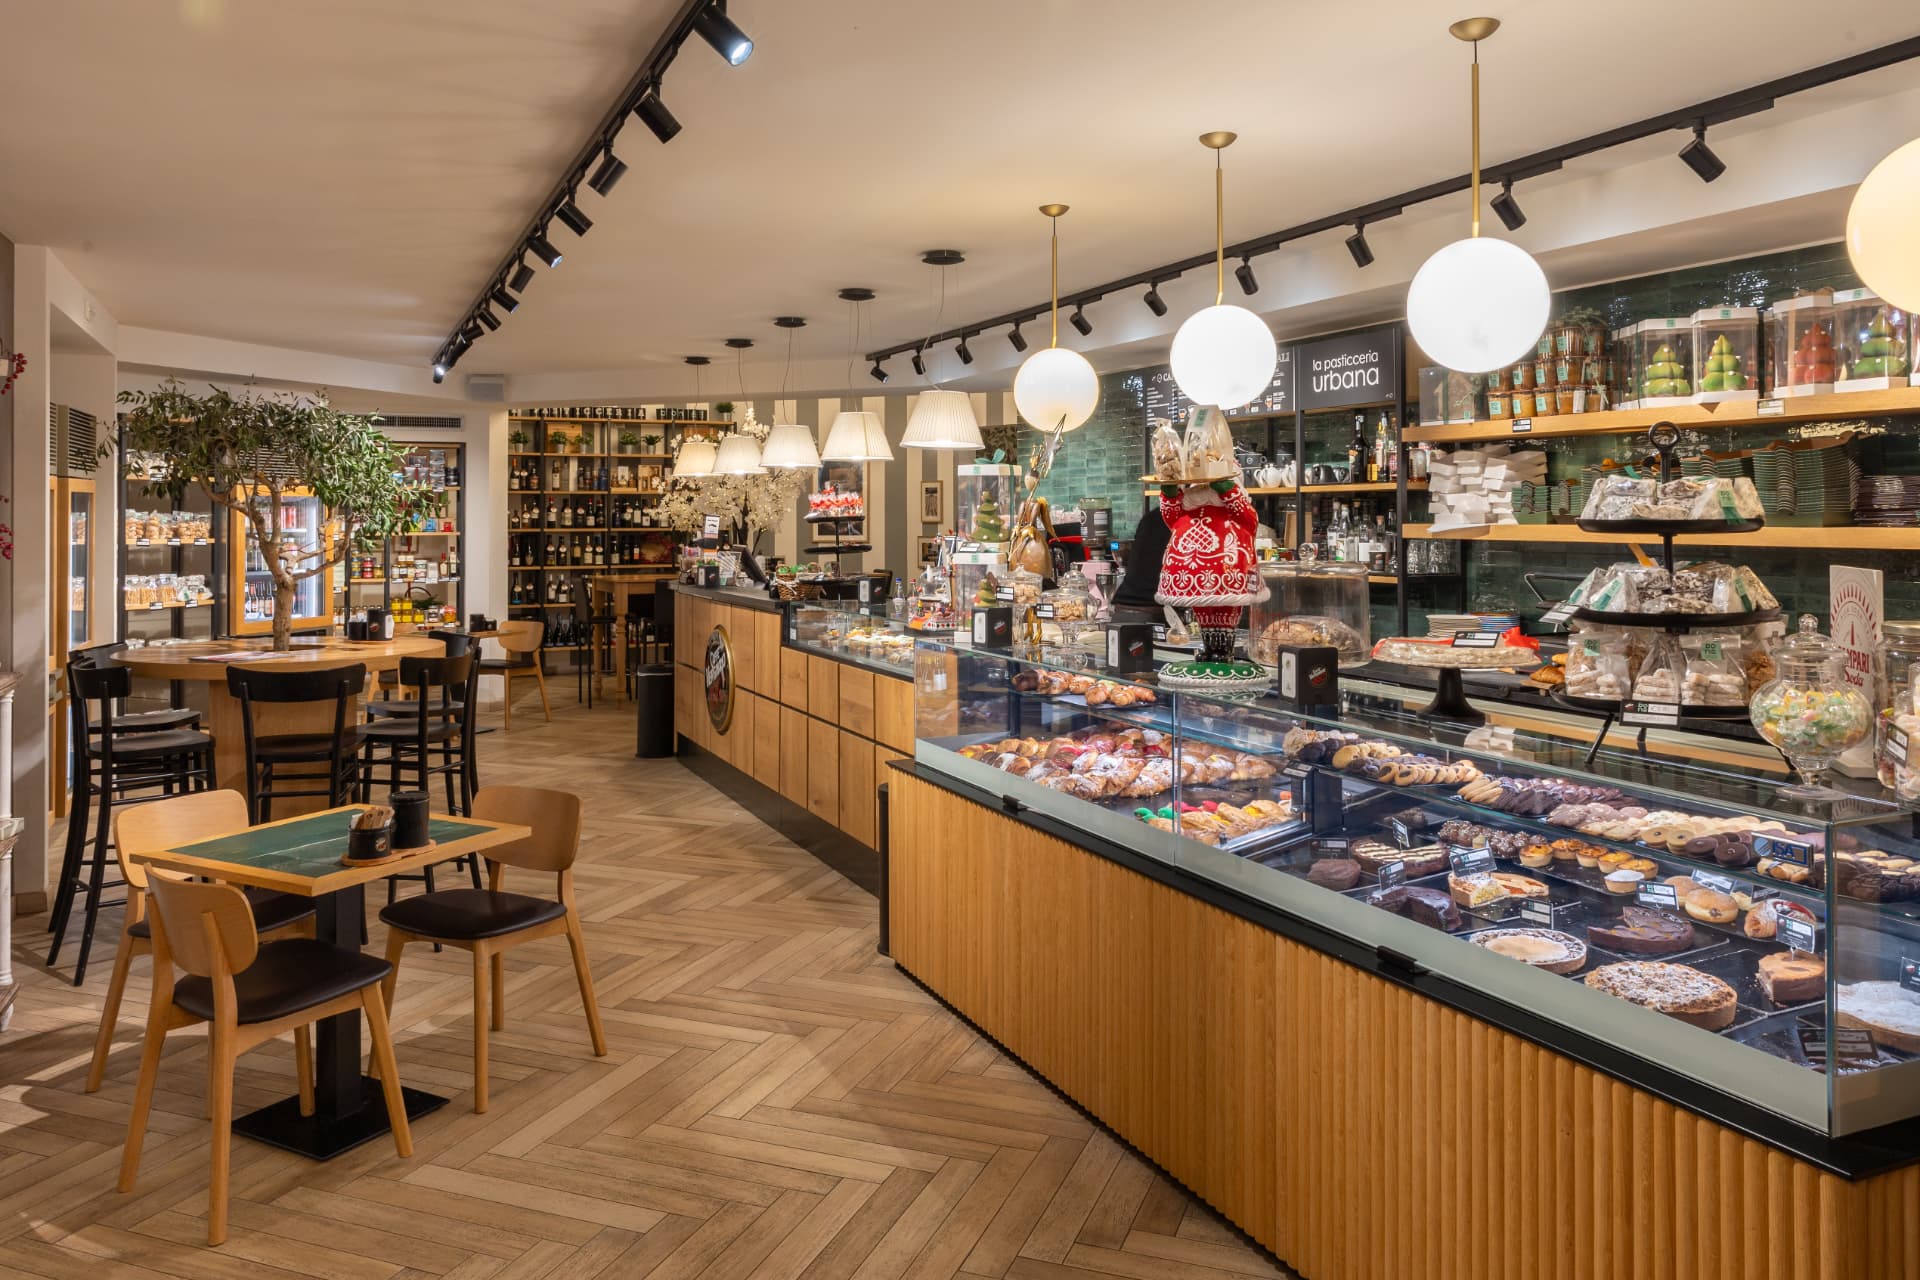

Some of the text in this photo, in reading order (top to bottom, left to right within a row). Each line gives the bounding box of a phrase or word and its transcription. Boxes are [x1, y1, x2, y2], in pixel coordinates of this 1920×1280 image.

[1313, 349, 1379, 371] la pasticceria
[1313, 367, 1379, 392] urbana
